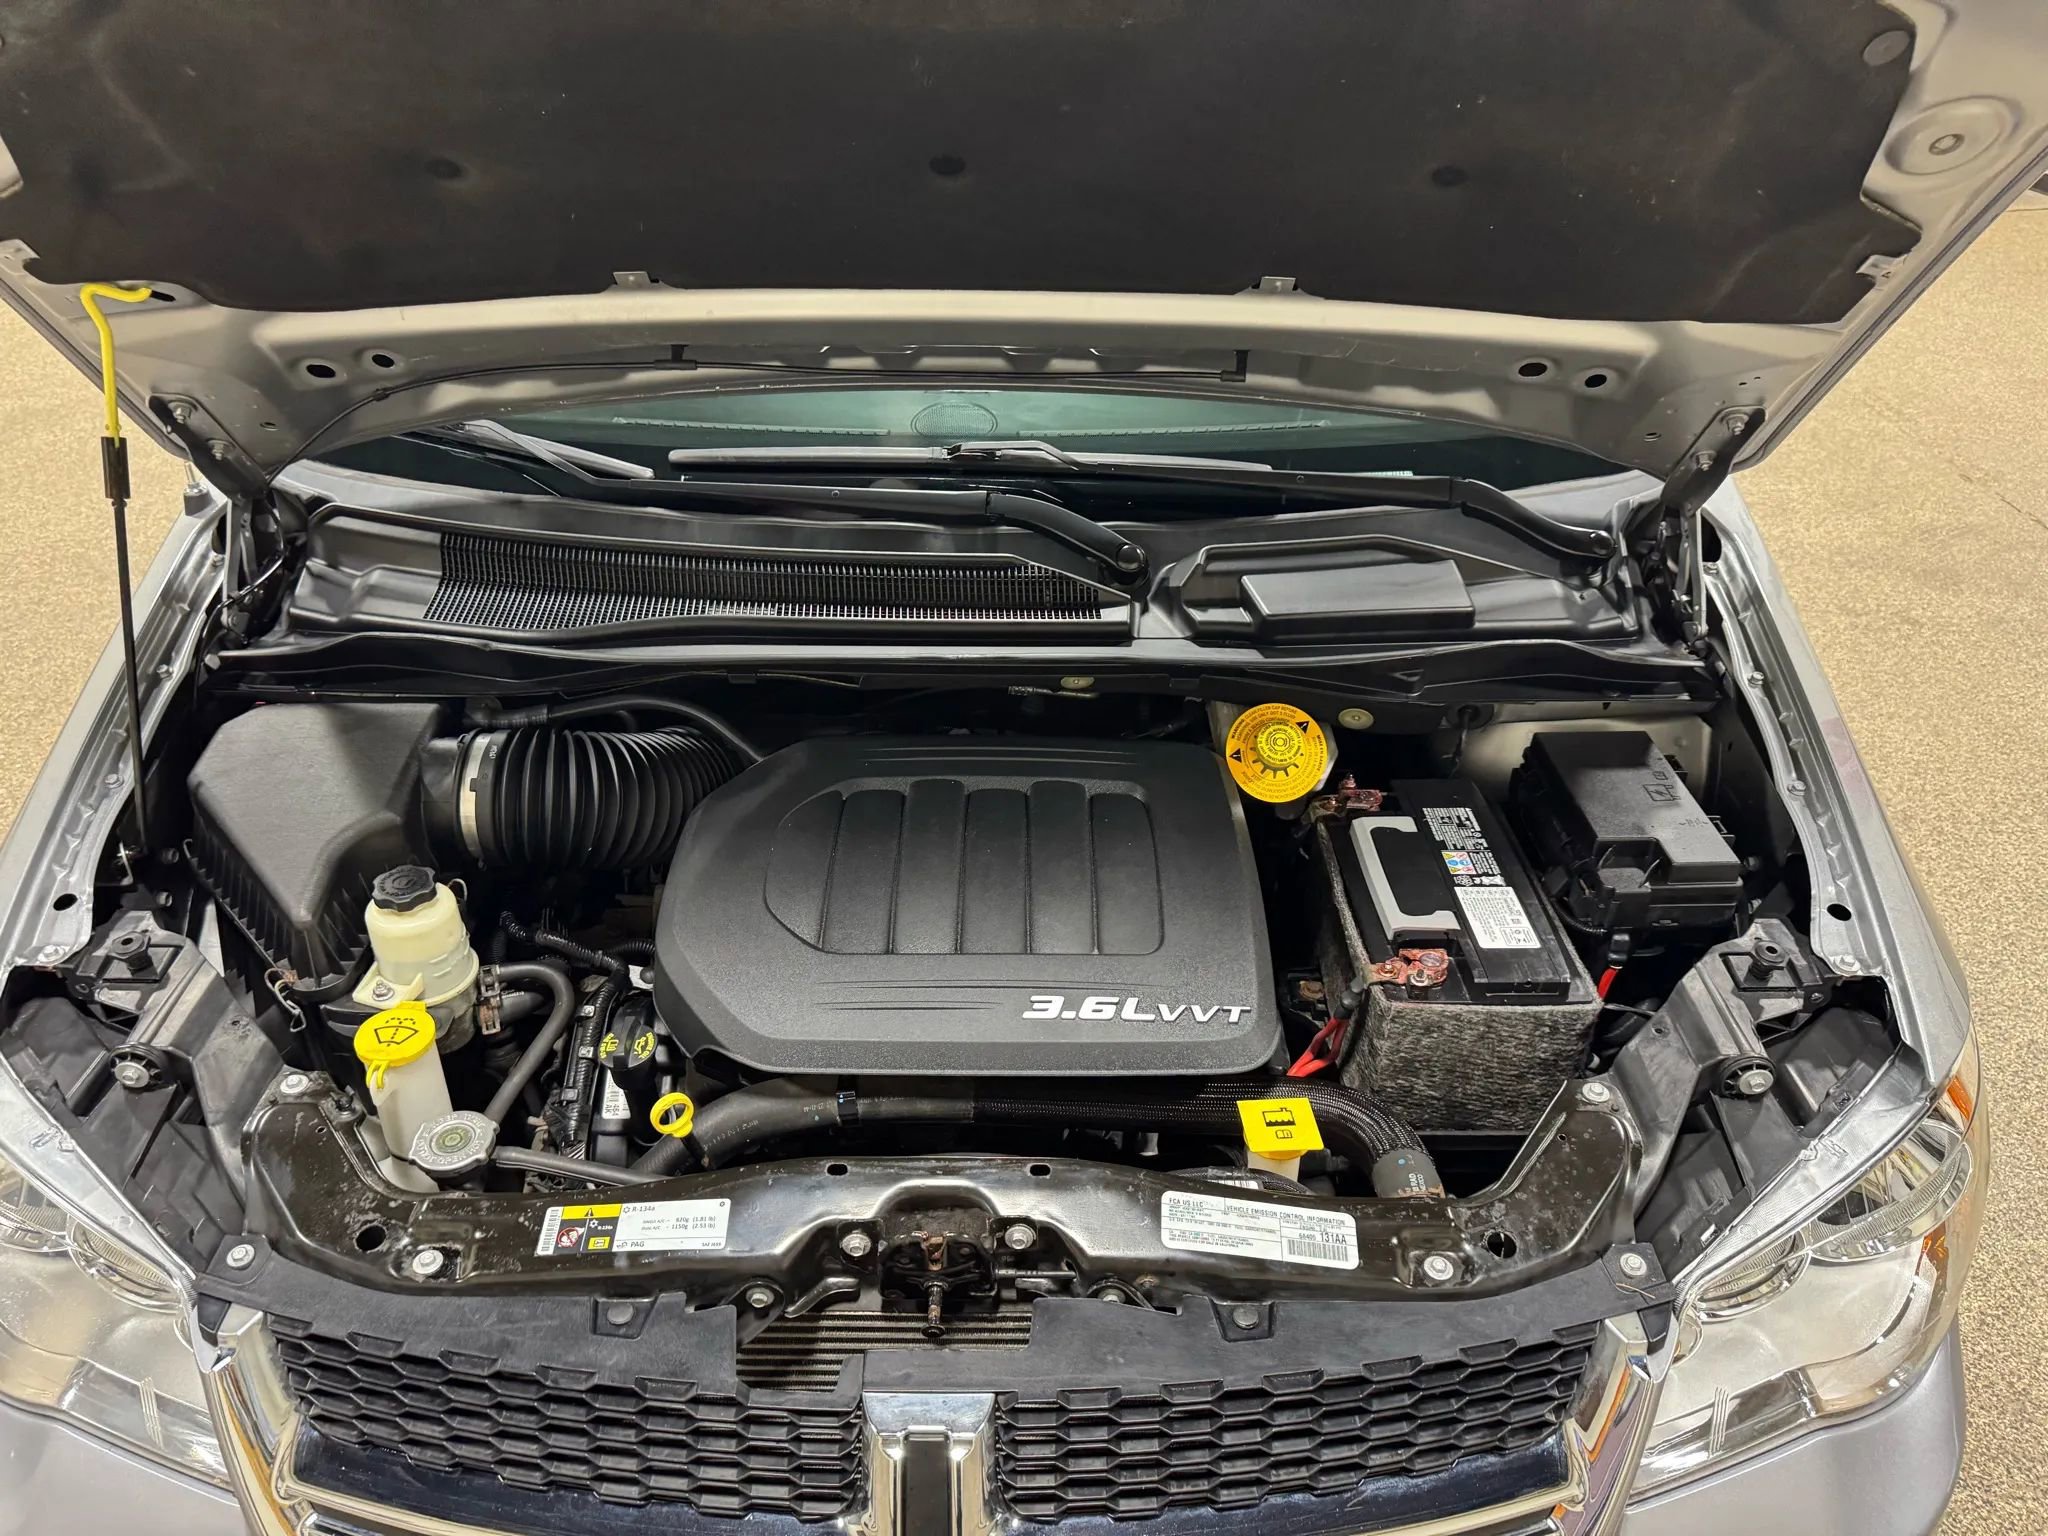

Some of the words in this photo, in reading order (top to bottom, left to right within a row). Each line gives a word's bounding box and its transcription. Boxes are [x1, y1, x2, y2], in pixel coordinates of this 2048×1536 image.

[1022, 995, 1156, 1021] 3.6L
[1157, 1003, 1251, 1024] VVT
[1226, 1205, 1249, 1214] VEHICLE
[1251, 1208, 1278, 1217] EMISSION
[1280, 1212, 1305, 1222] CONTROL
[1307, 1215, 1346, 1226] INFORMATION
[1320, 1232, 1347, 1245] 131AA
